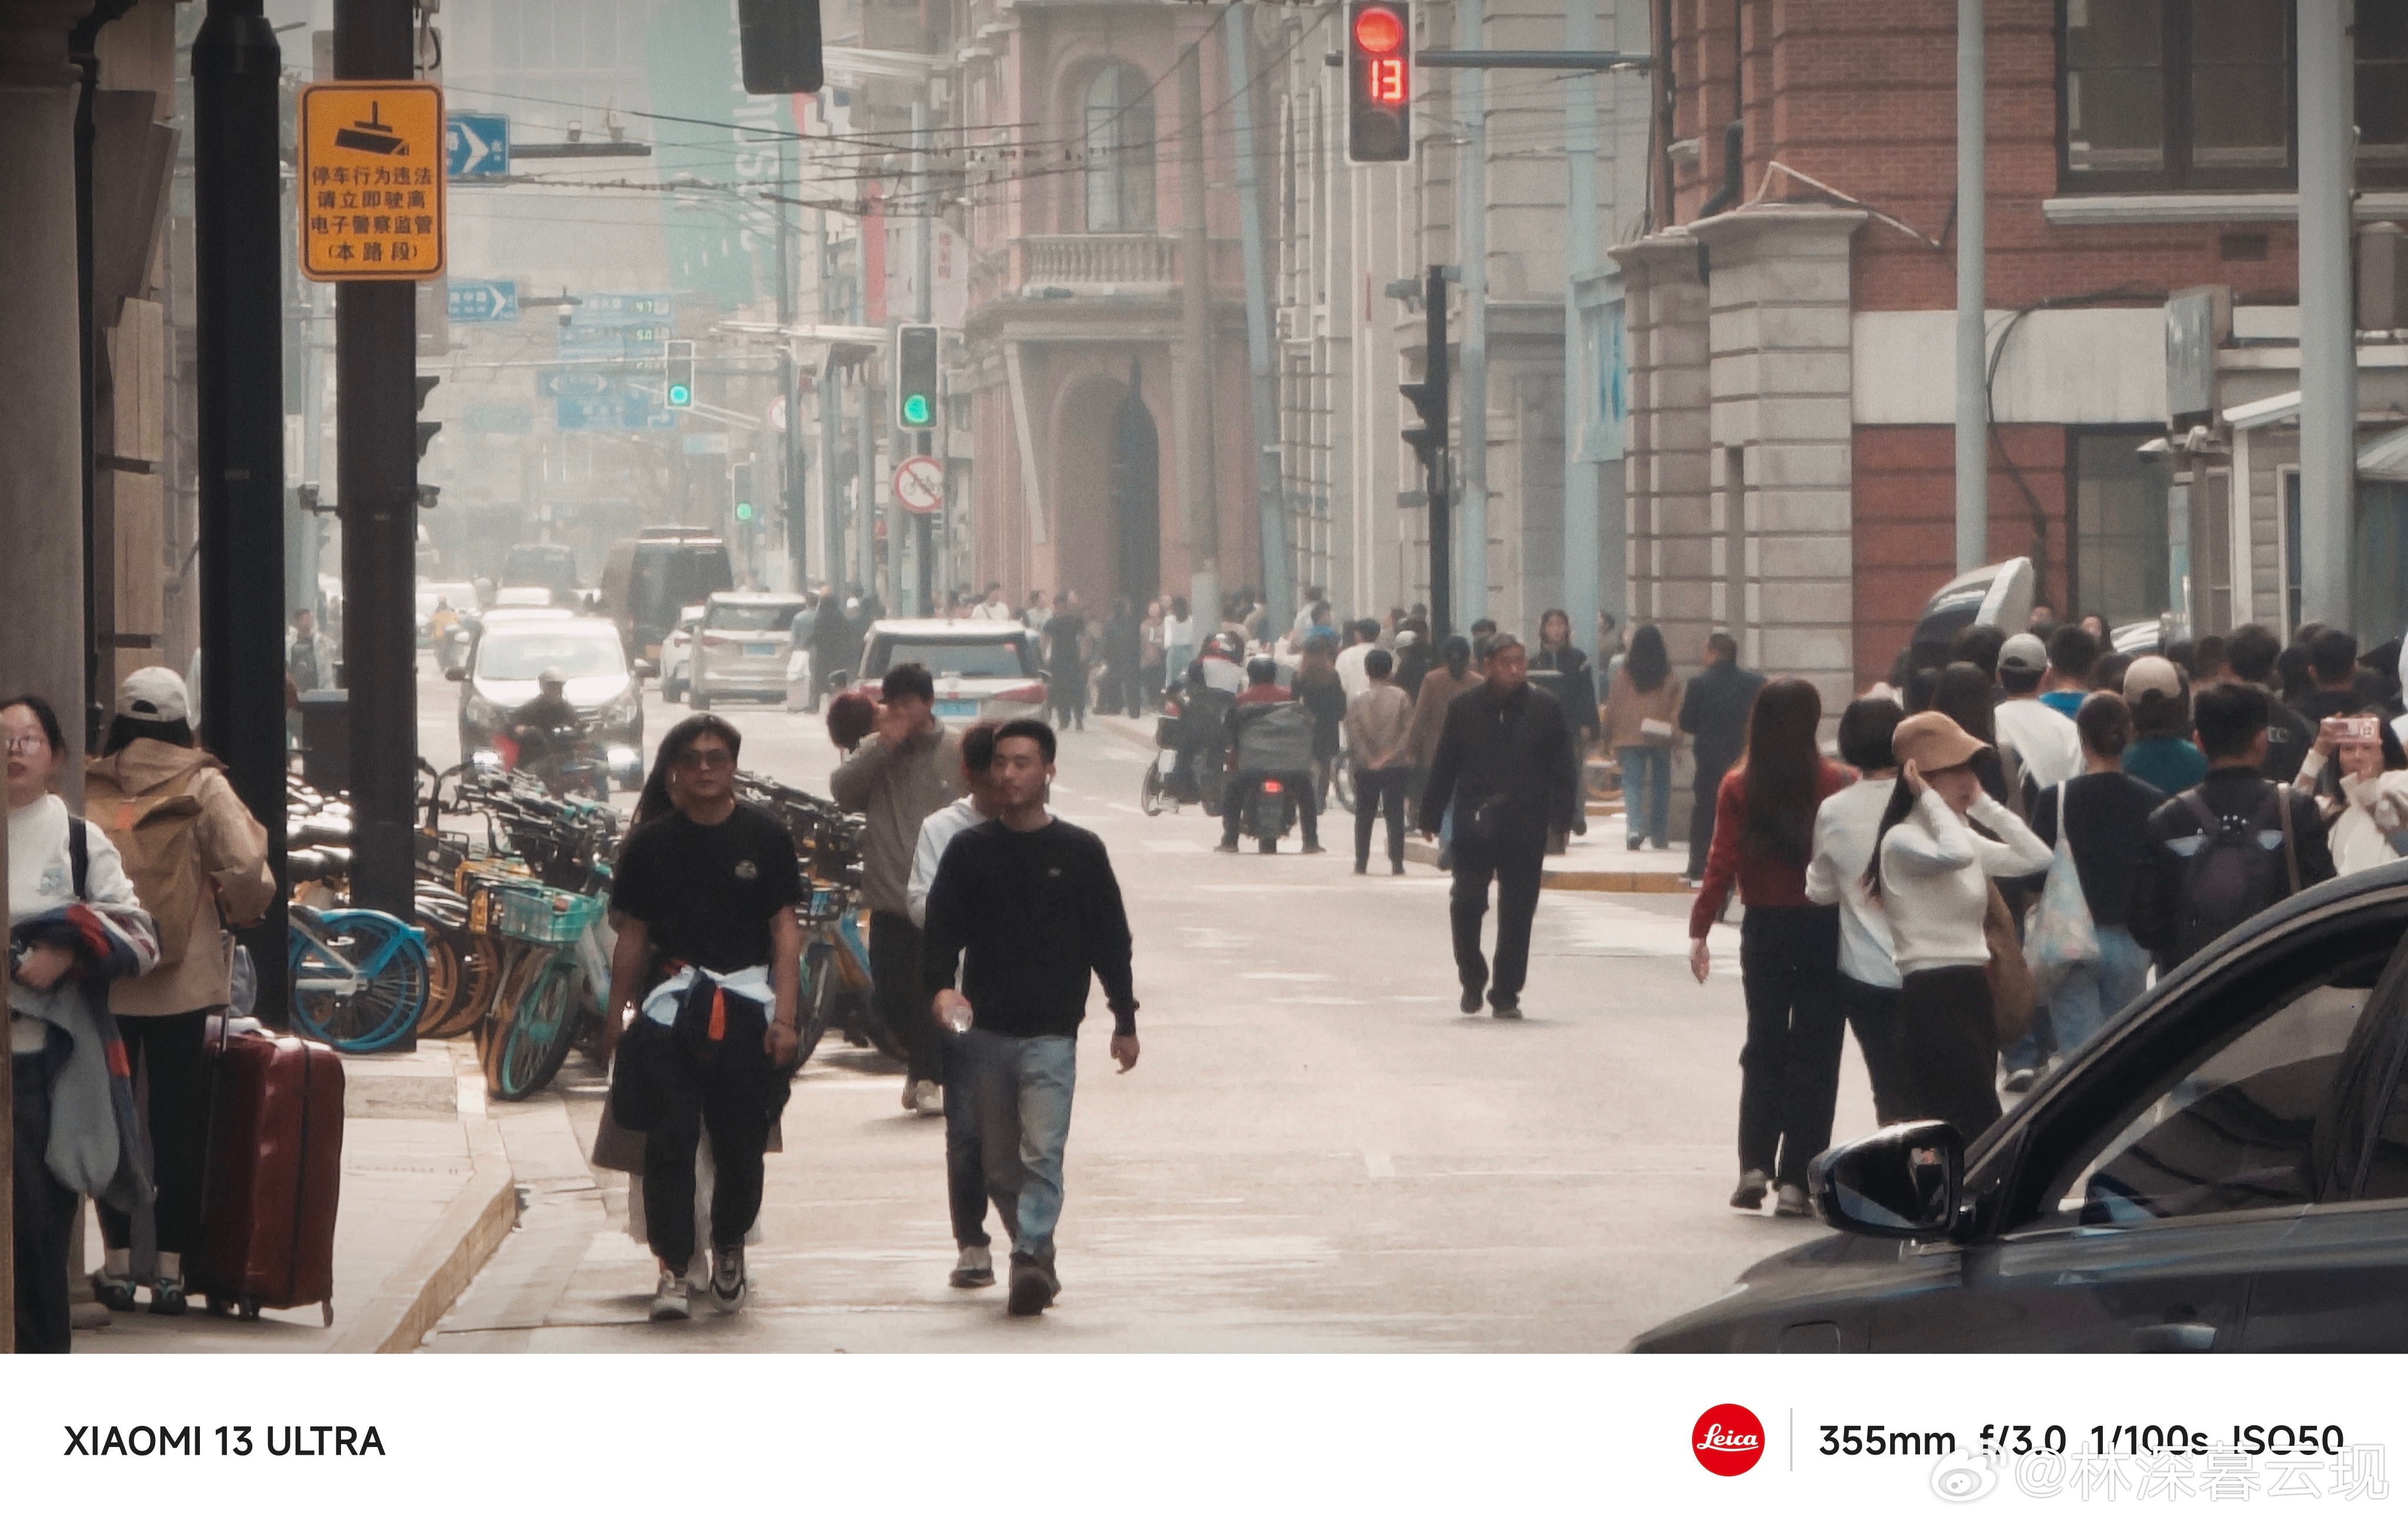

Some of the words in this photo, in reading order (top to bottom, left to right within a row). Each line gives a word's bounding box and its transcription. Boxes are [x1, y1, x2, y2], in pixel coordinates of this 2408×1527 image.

[1372, 59, 1402, 99] 13
[312, 166, 432, 186] 停车行为违法
[317, 190, 425, 209] 请立即驶离
[312, 215, 432, 235] 电子警察监管
